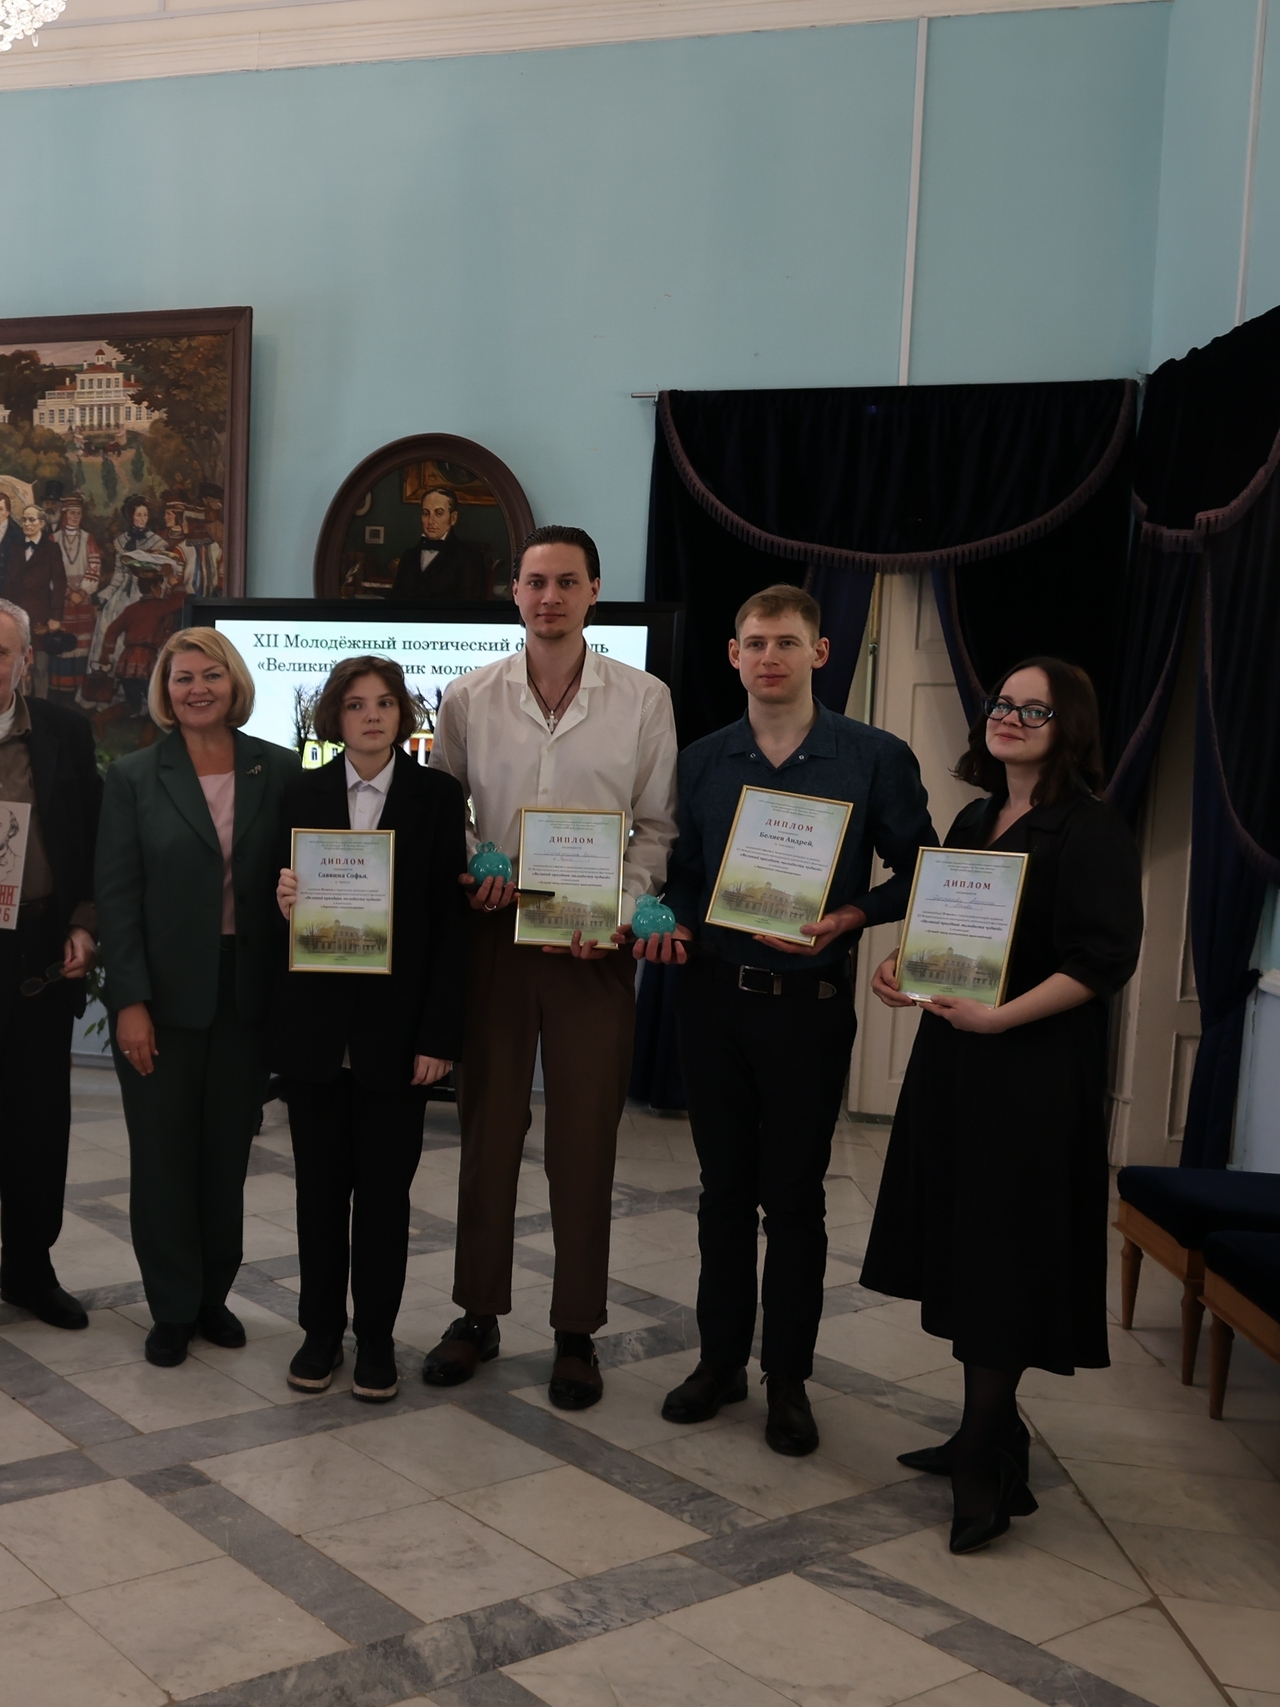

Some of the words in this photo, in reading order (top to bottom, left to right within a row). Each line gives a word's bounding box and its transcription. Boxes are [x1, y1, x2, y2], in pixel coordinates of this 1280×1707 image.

[253, 633, 279, 648] XII
[284, 634, 397, 650] Молодёжный
[402, 637, 510, 651] поэтический
[765, 818, 813, 833] ДИПЛОМ
[549, 836, 594, 844] ДИПЛОМ
[759, 831, 785, 842] Беляев
[785, 837, 814, 848] Андрей,
[320, 857, 365, 866] ДИПЛОМ
[943, 879, 991, 890] ДИПЛОМ
